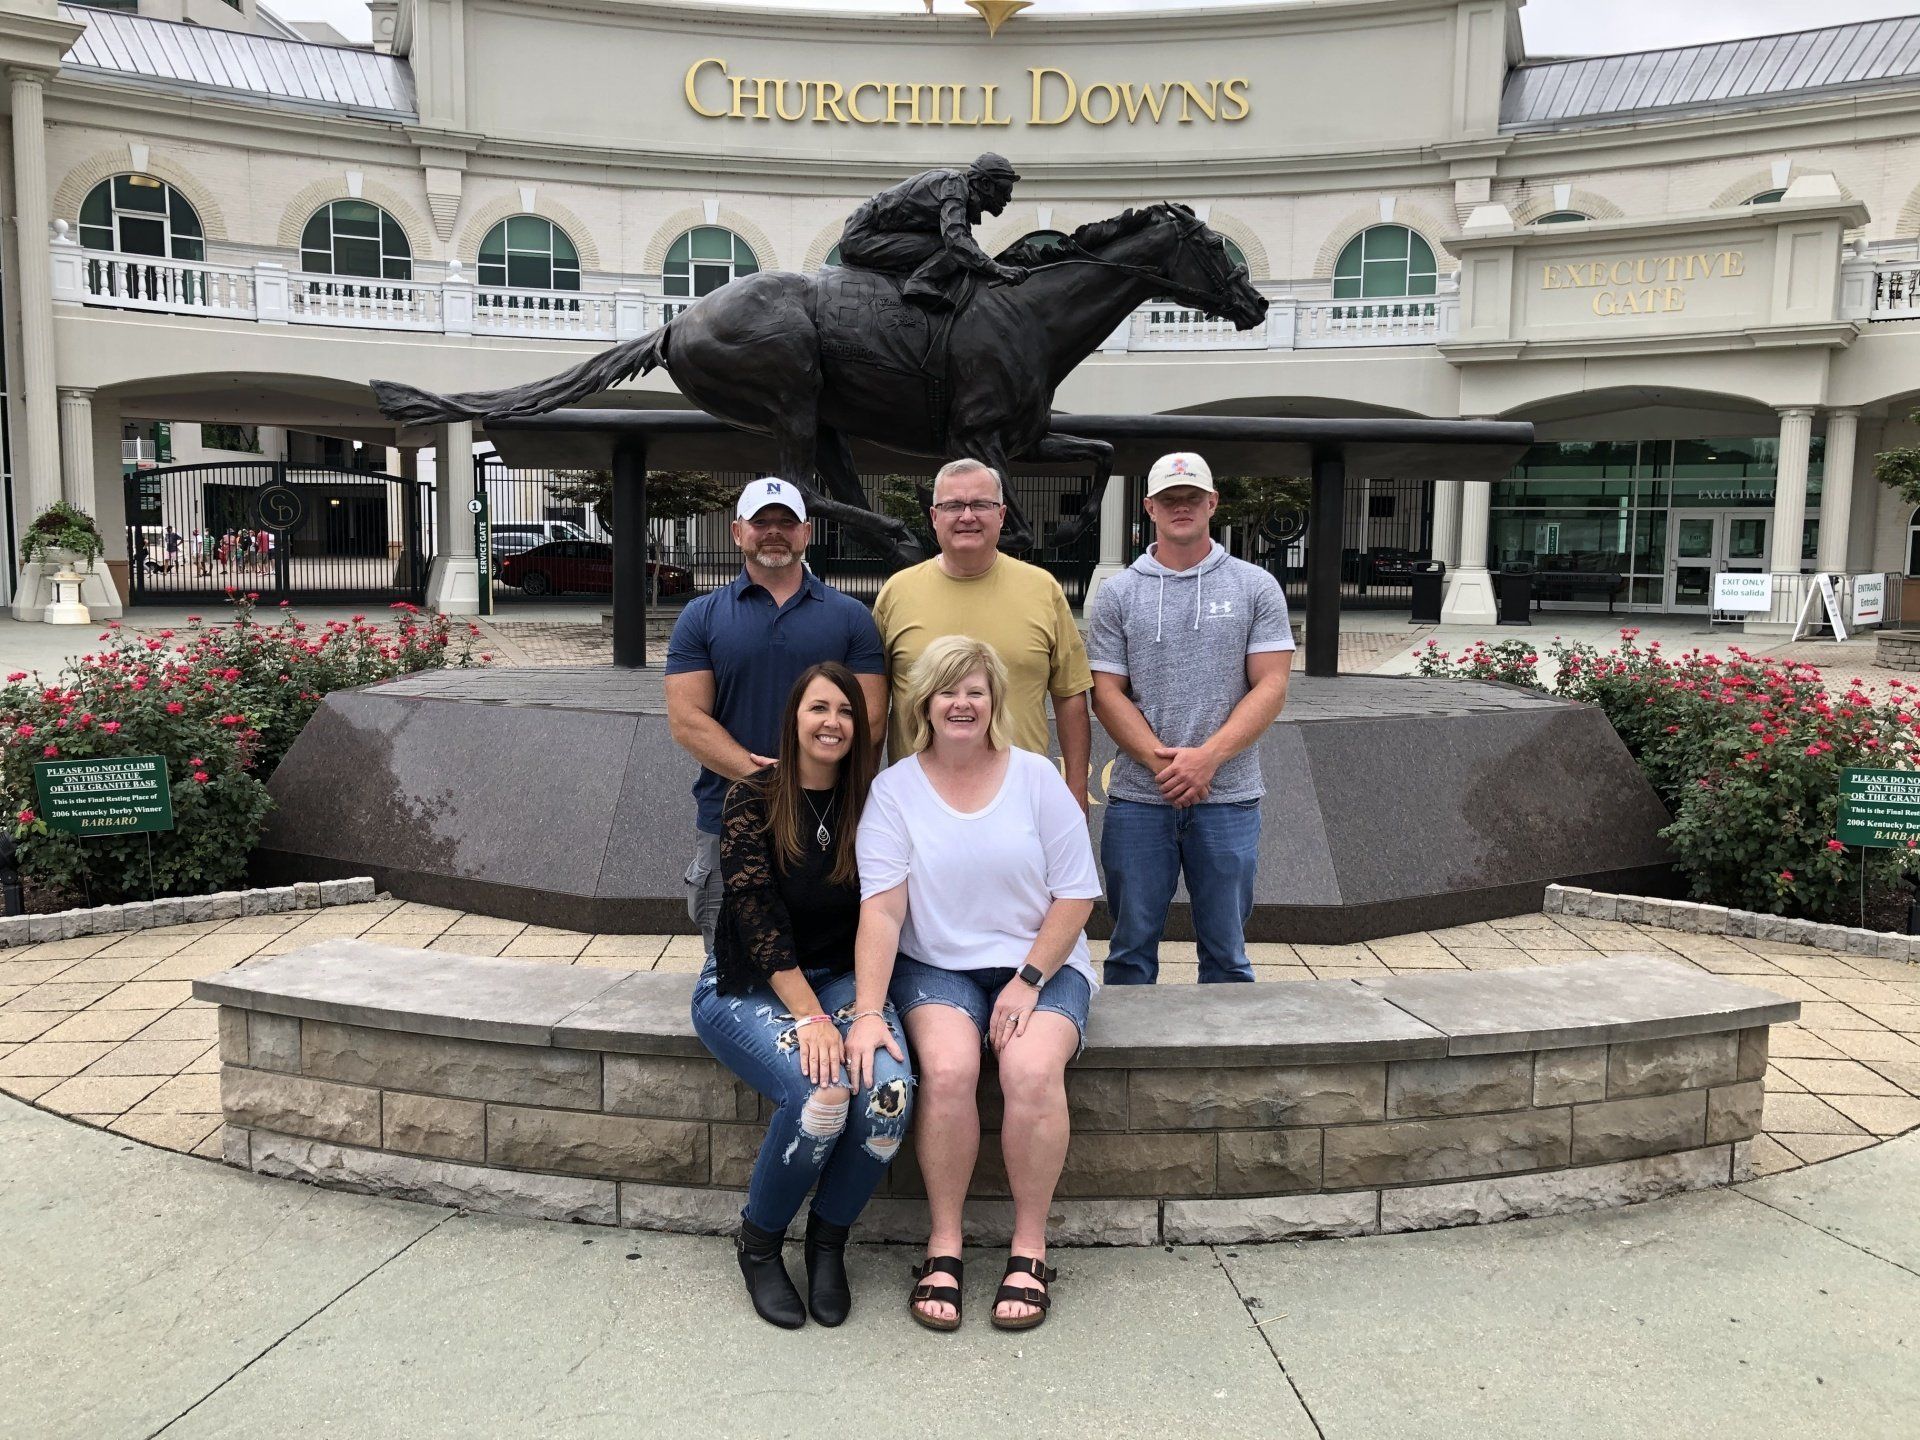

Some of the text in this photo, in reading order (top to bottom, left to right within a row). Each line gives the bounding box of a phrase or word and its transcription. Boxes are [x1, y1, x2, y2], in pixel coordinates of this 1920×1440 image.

[1541, 251, 1745, 290] EXECUTIVE
[1592, 286, 1685, 316] GATE
[767, 482, 781, 491] N
[1698, 489, 1767, 500] EXECUTIVE
[479, 521, 487, 542] GATE
[1858, 582, 1881, 593] ENTRANCE
[1861, 597, 1879, 607] Entrada
[47, 762, 156, 775] PLEASE DO NOT CLIMB
[80, 774, 103, 782] THIS
[104, 772, 141, 781] STATUE
[1852, 774, 1888, 782] PLEASE
[50, 780, 157, 793] OR THE GRANITE BASE
[1851, 792, 1865, 800] OR
[1867, 793, 1887, 801] THE
[52, 810, 70, 818] 2006
[71, 809, 107, 818] Kentucky
[110, 807, 132, 816] Derby
[81, 816, 138, 827] BARBARO
[1867, 820, 1904, 830] Kentucky
